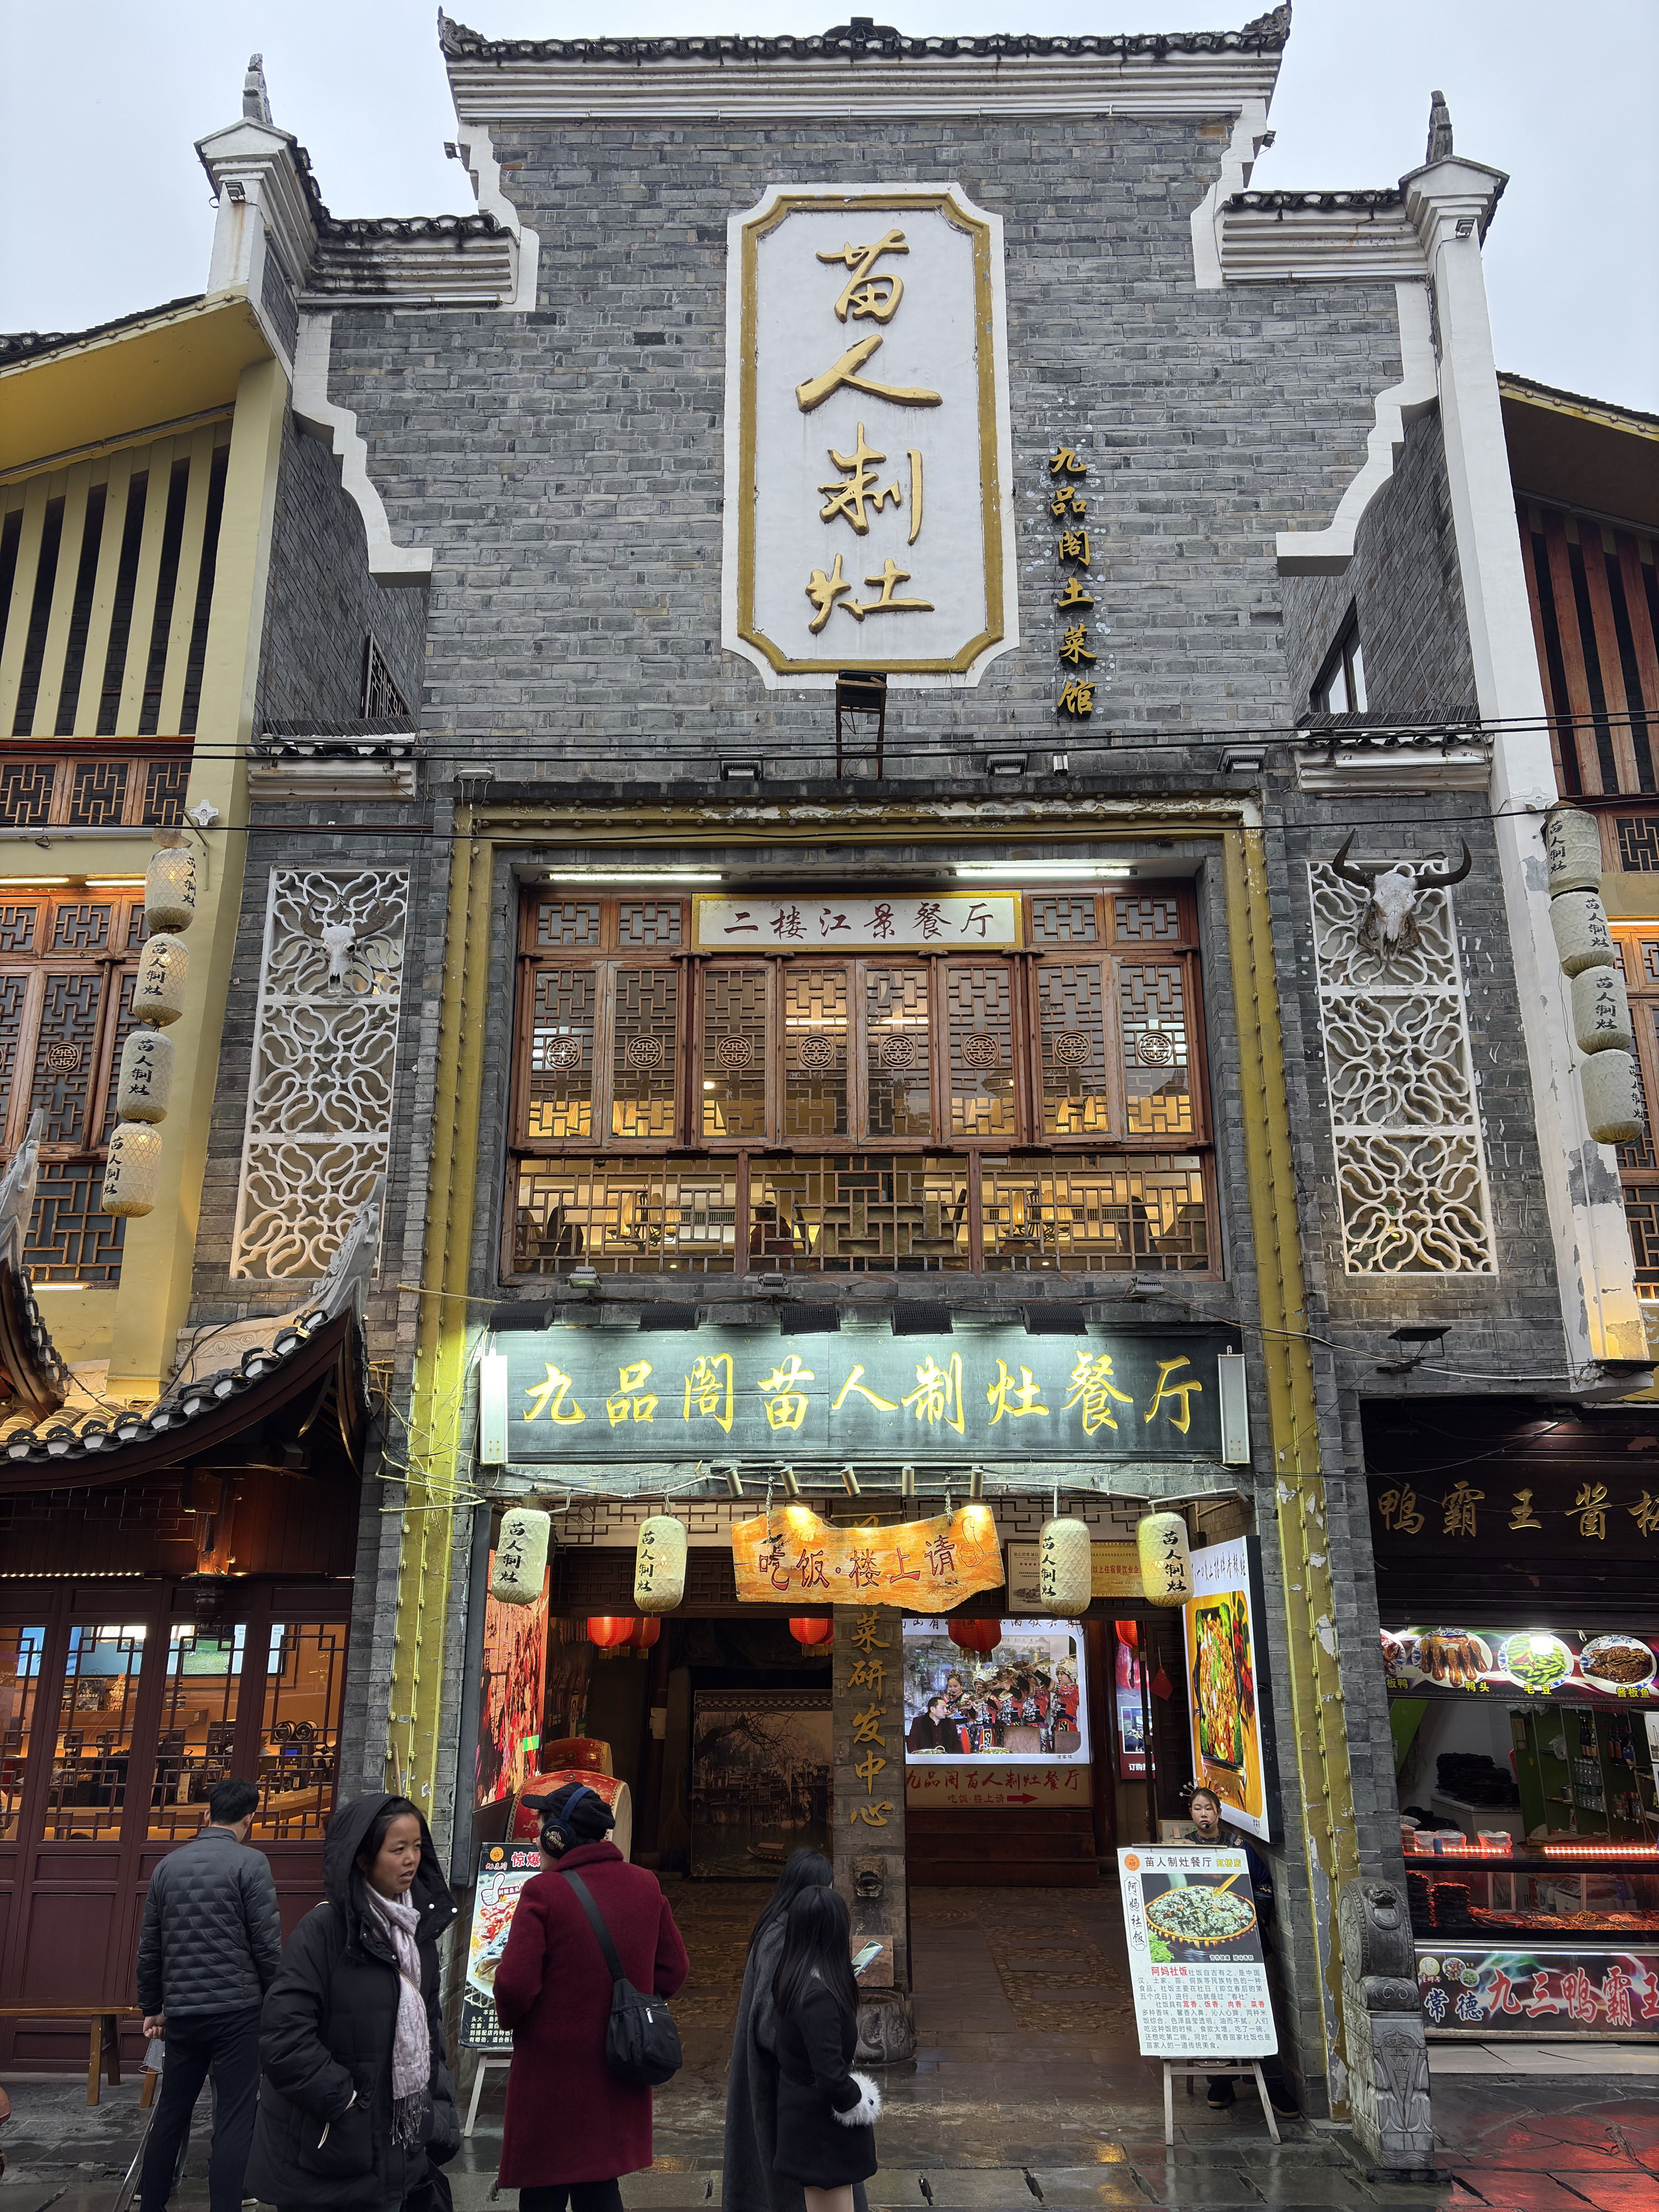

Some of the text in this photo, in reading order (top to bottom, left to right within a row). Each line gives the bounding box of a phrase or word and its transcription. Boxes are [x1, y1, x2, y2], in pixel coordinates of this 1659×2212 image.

[795, 229, 943, 634] 苗人制灶
[1550, 821, 1567, 874] 苗人制灶
[182, 856, 196, 907] 苗人制灶
[723, 902, 994, 938] 二楼江景餐厅
[1584, 899, 1609, 948] 苗人制灶
[141, 942, 168, 996] 苗人制灶
[1595, 977, 1617, 1031] 苗人制灶
[128, 1039, 154, 1096] 苗人制灶
[103, 1136, 124, 1196] 苗人制灶
[498, 1522, 525, 1584] 苗人制灶
[637, 1532, 655, 1593] 苗人制灶
[1041, 1536, 1057, 1597] 苗人制灶
[1091, 1565, 1142, 1574] 以上住宿餐饮业企
[1162, 1530, 1187, 1593] 苗人制灶
[847, 1515, 891, 1827] 菜研发中心
[1465, 1681, 1490, 1692] 鸭头
[1524, 1683, 1552, 1695] 毛豆
[1616, 1686, 1651, 1698] 酱板鱼
[906, 1768, 1080, 1791] 九品阁苗人制灶餐厅
[1145, 1856, 1241, 1867] 苗人制灶餐厅 虹桥店
[1128, 1881, 1145, 1947] 阿妈社饭
[1425, 1987, 1483, 2023] 常德
